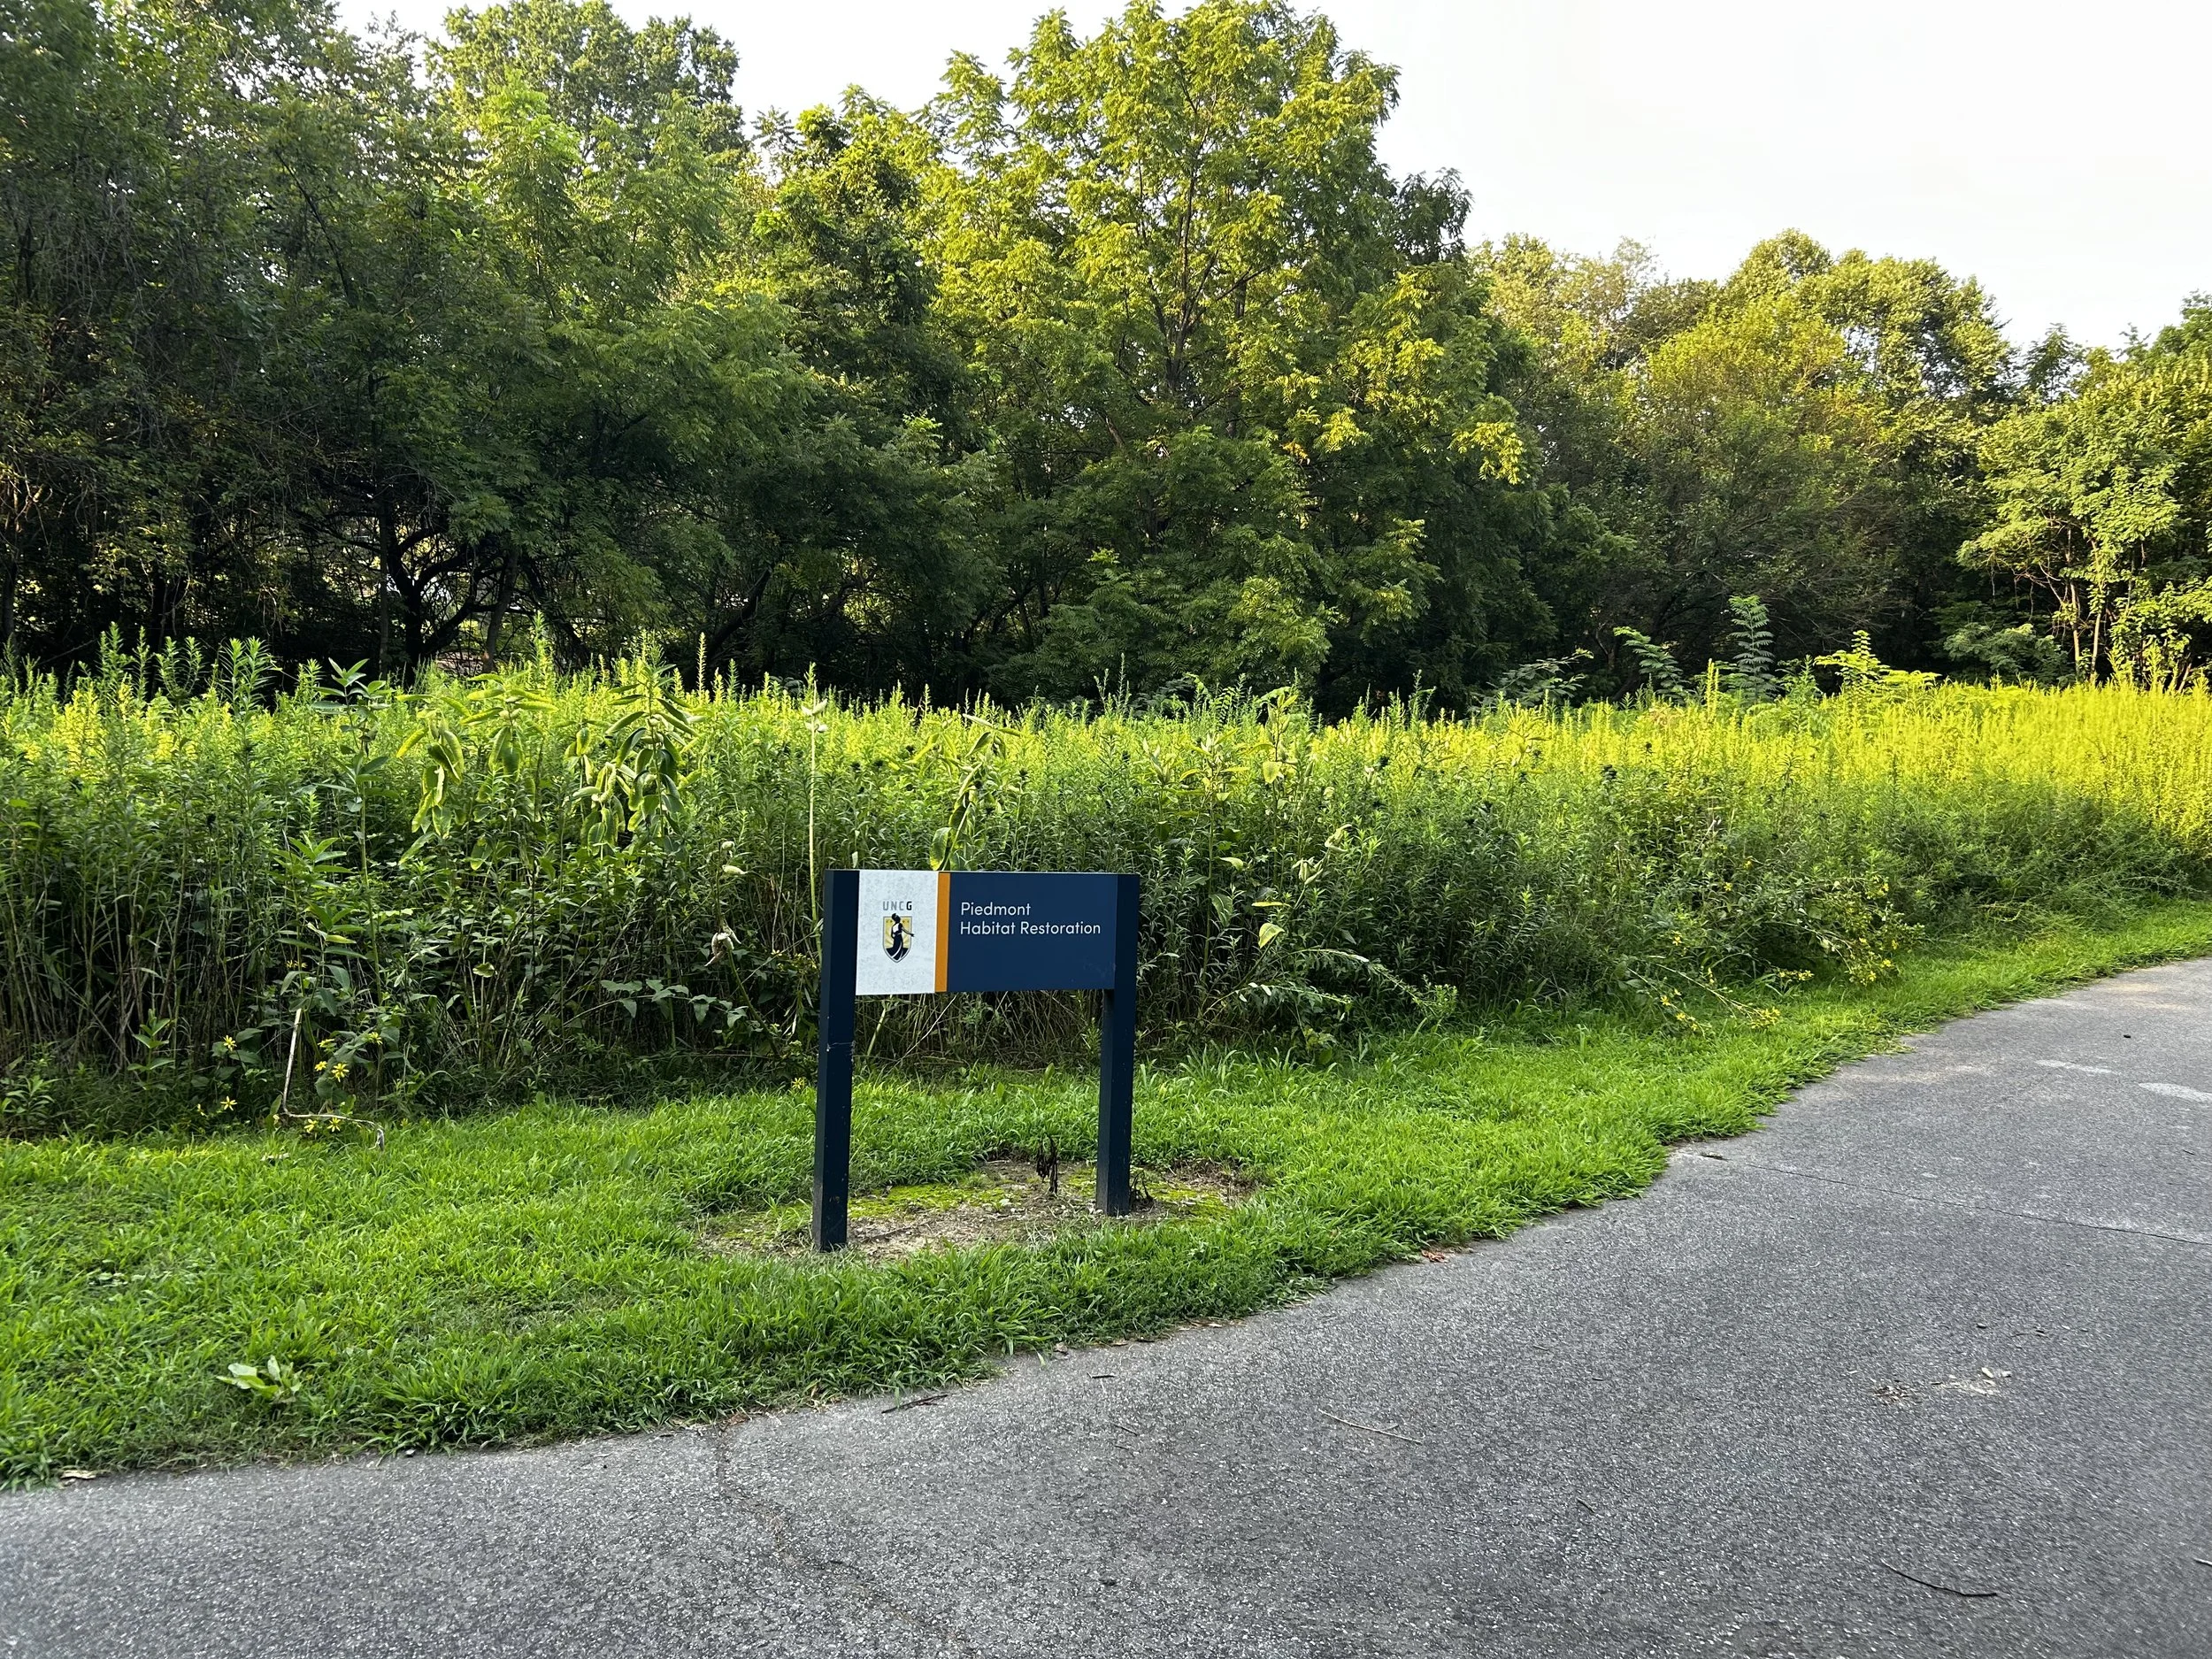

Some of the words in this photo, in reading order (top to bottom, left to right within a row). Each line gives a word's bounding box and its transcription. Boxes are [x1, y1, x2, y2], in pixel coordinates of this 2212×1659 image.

[882, 901, 912, 910] UNCG
[961, 902, 1031, 915] Piedmont
[961, 921, 1016, 934] Habitat
[1020, 921, 1100, 934] Restoration
